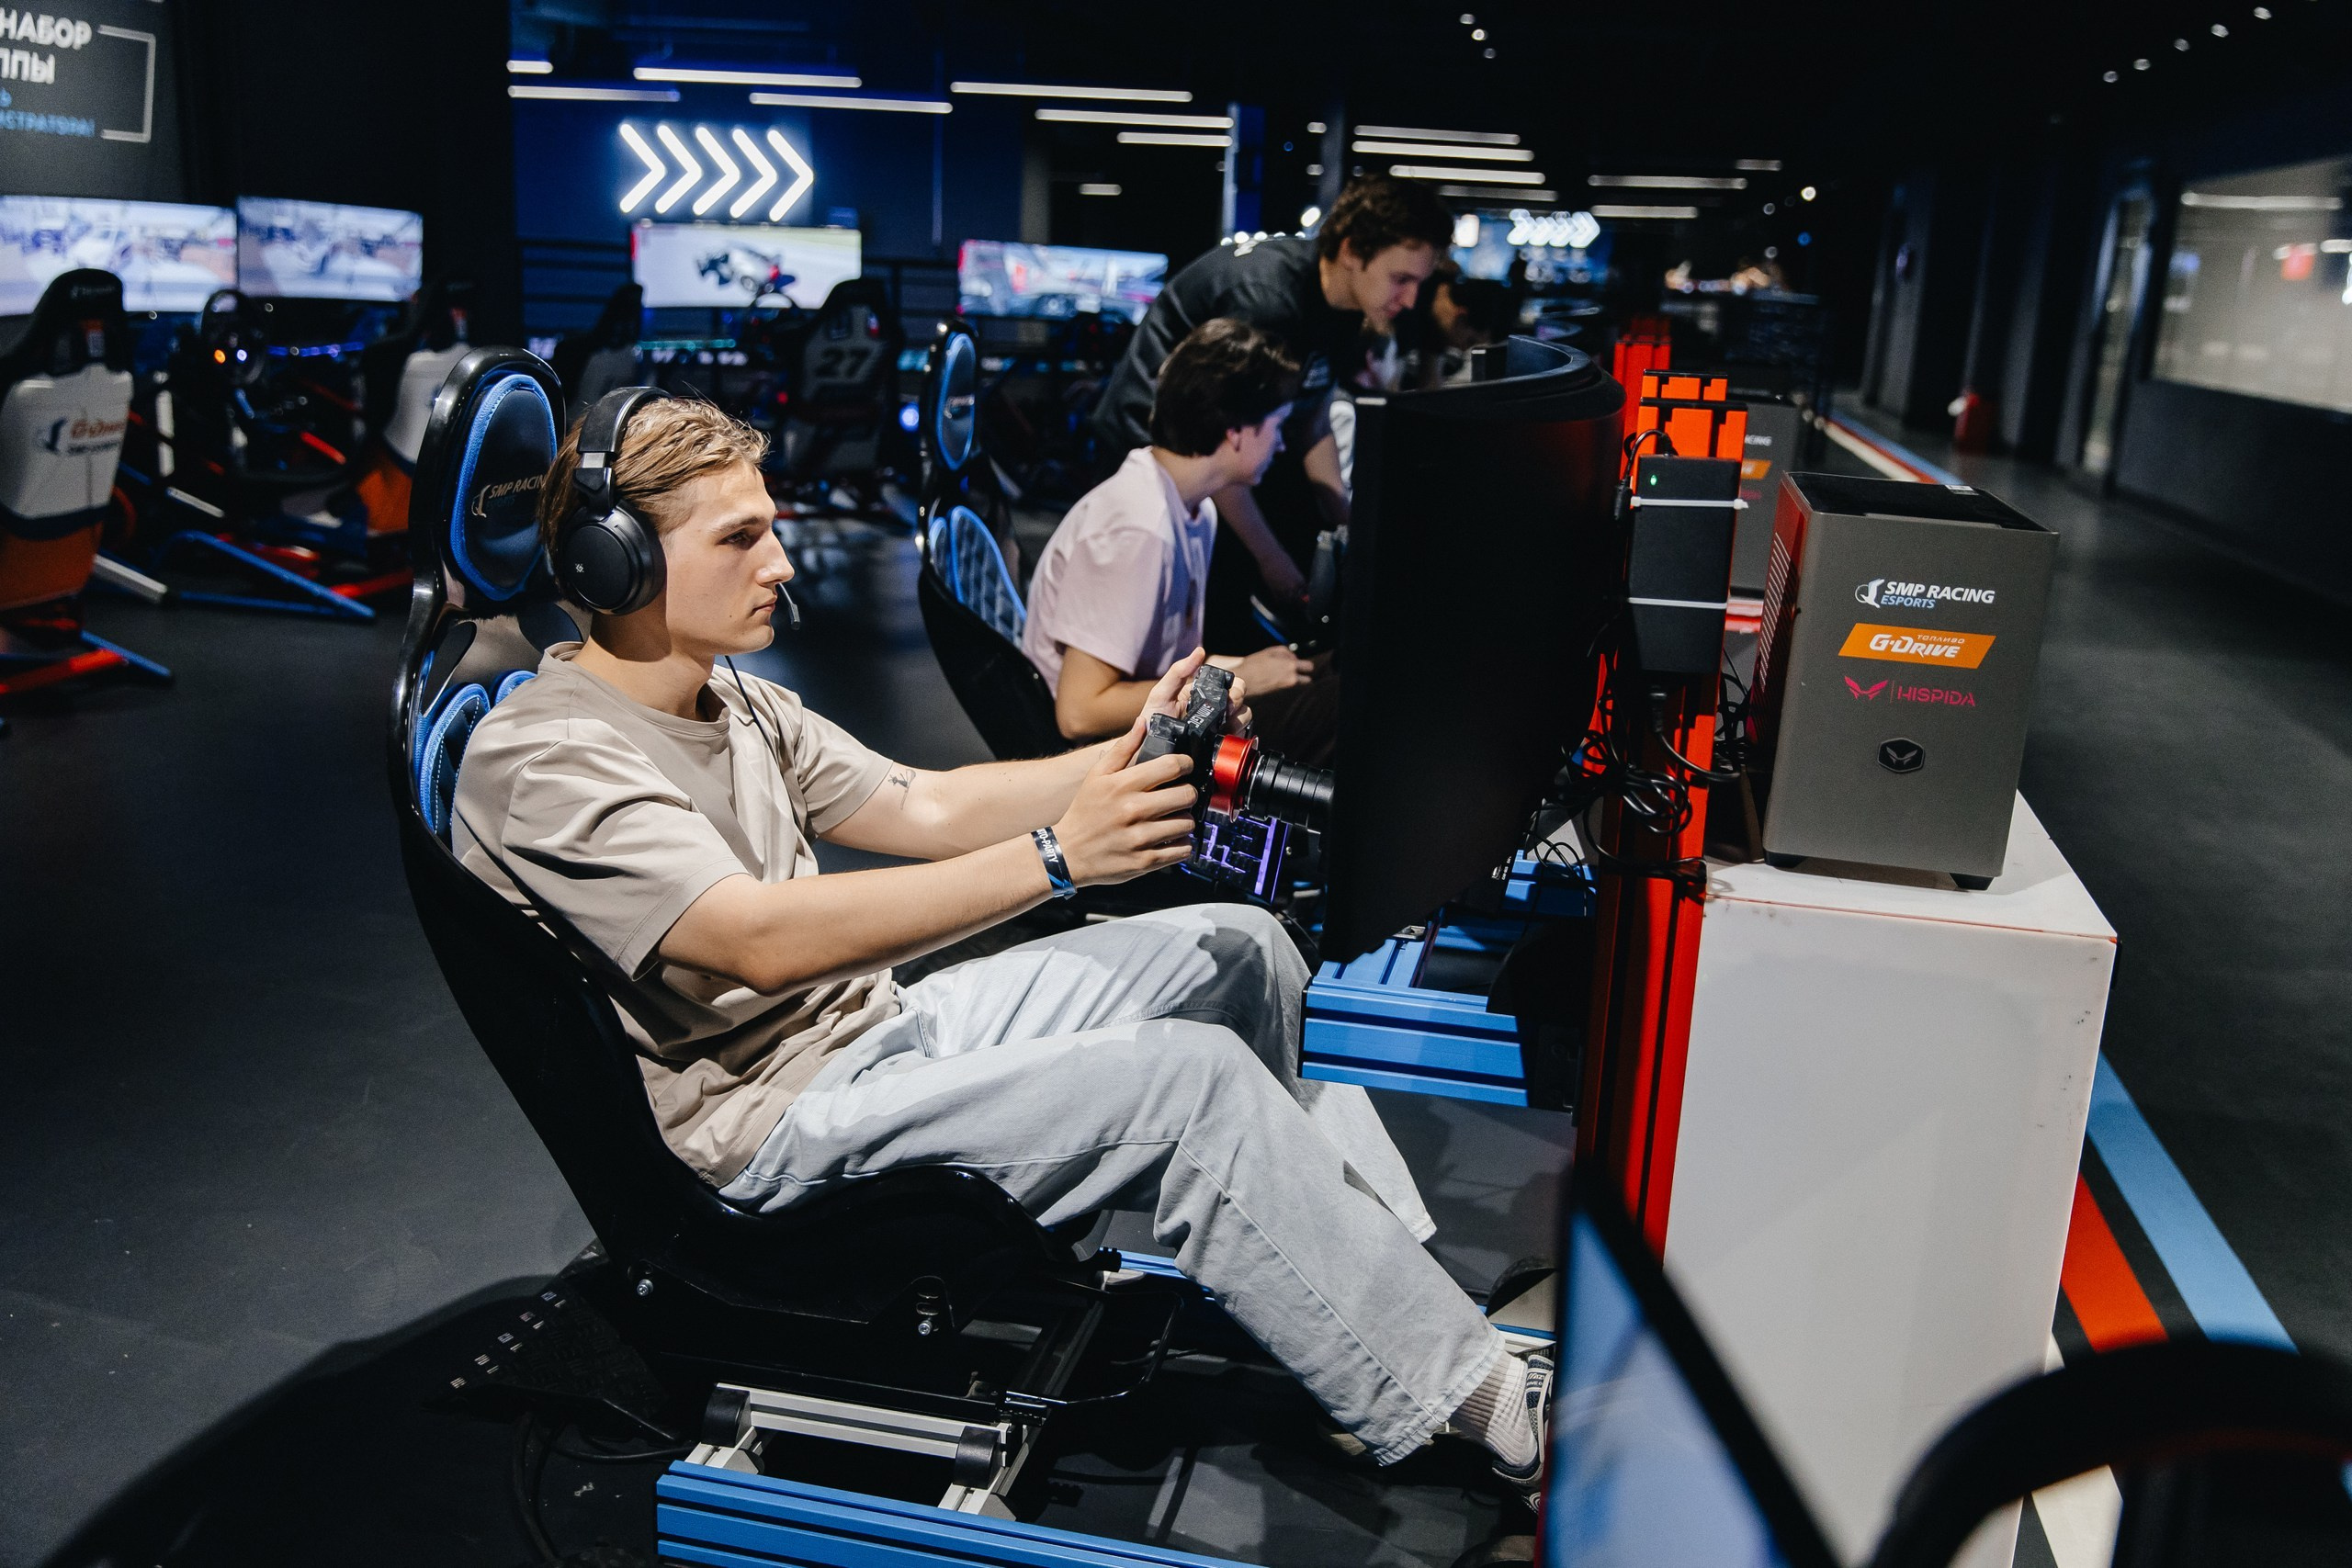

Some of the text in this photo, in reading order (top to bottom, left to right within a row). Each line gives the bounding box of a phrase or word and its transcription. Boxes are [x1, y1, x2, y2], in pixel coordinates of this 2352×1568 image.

[0, 7, 92, 51] НАБОР
[815, 346, 870, 378] 27
[489, 474, 547, 499] SMP RACIN
[1881, 595, 1936, 608] ESPORTS
[1884, 581, 1995, 604] SMP RACING
[1897, 686, 1975, 706] HISPIDA
